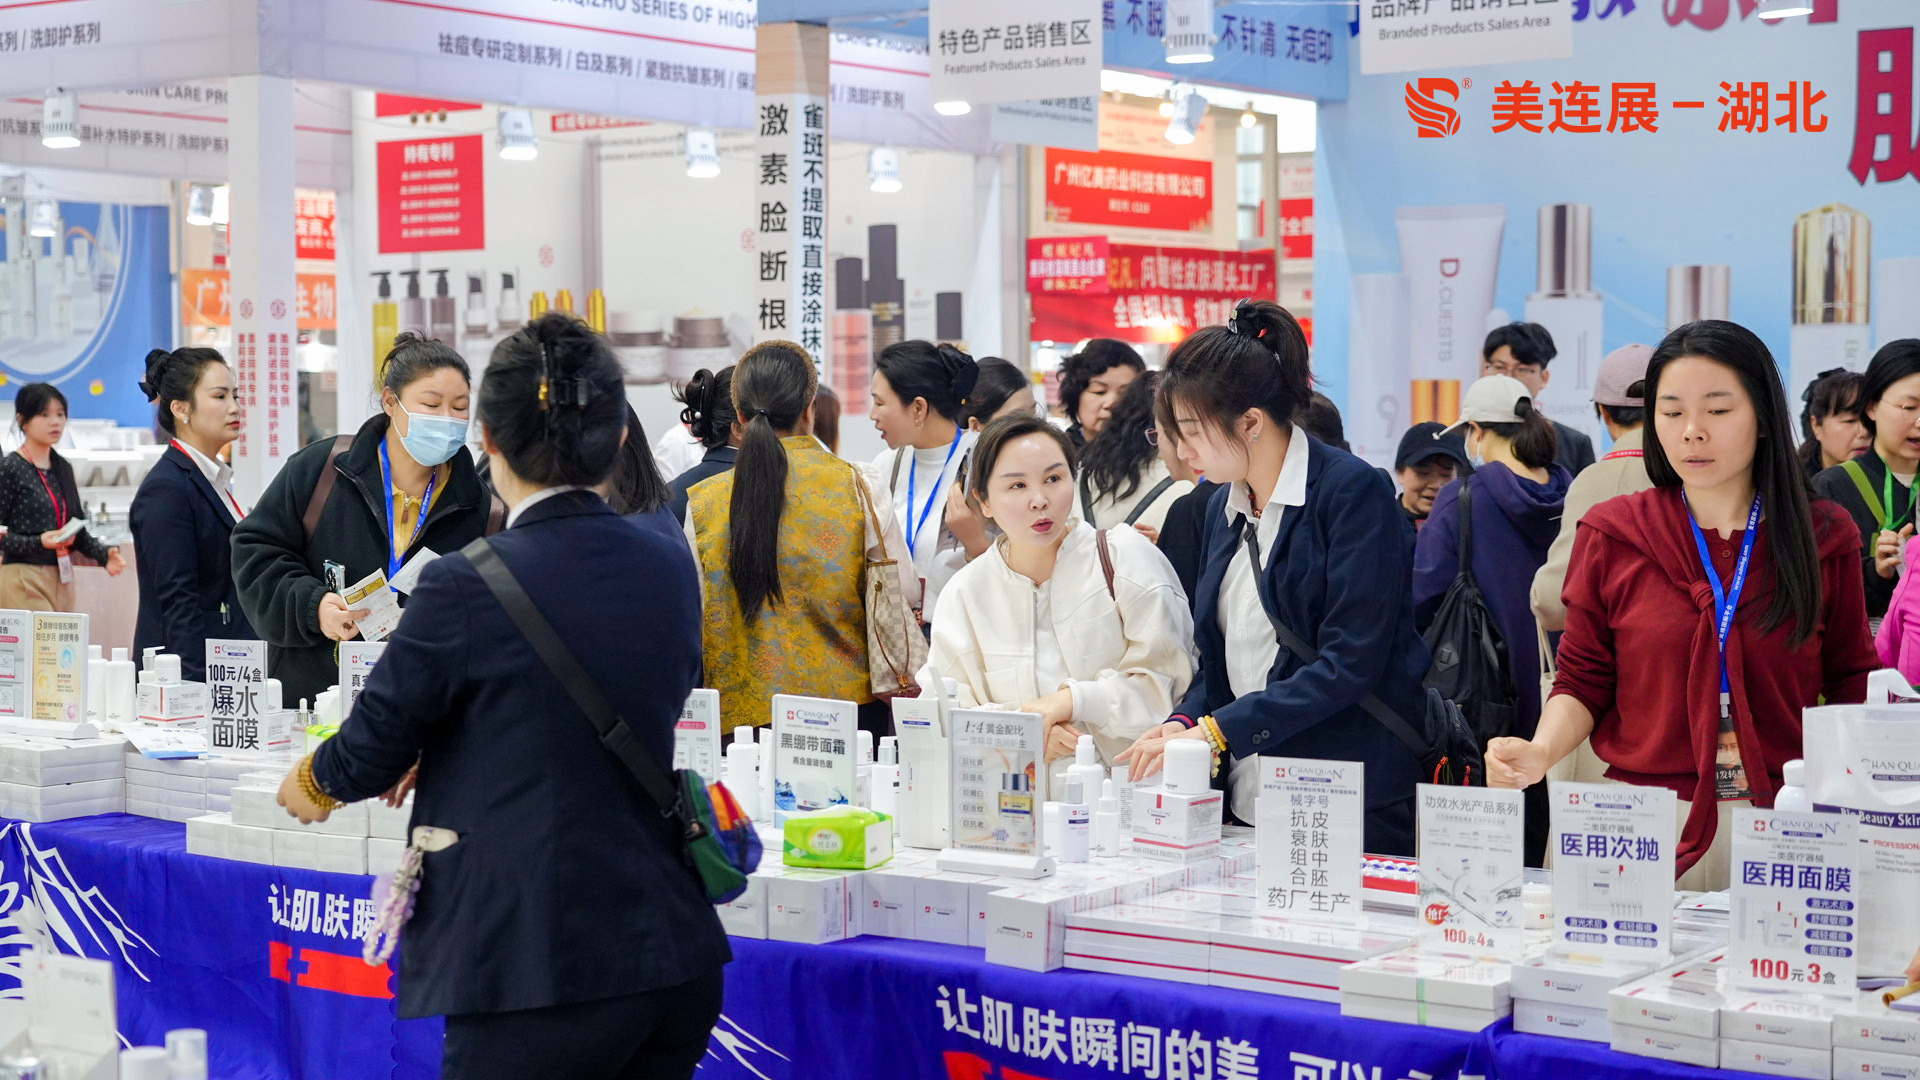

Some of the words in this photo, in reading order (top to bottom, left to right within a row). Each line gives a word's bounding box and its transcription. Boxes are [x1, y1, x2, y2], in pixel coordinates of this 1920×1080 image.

[631, 0, 688, 21] SERIES
[692, 5, 714, 24] OF
[30, 22, 101, 48] 洗卸护系列
[939, 19, 1091, 56] 特色产品销售区
[1379, 24, 1428, 41] Branded
[1431, 20, 1485, 36] Products
[1488, 17, 1519, 31] Sales
[1522, 15, 1551, 28] Area
[575, 51, 632, 77] 白及系列
[944, 61, 987, 75] Featured
[990, 57, 1033, 71] Products
[1036, 56, 1060, 69] Sales
[1064, 55, 1086, 67] Area
[759, 103, 788, 330] 激素脸断根
[210, 684, 260, 717] 爆水
[211, 717, 260, 750] 面膜
[985, 723, 1024, 736] 黄金配比
[780, 732, 847, 755] 黑绷带面霜
[1290, 793, 1330, 808] 械字号
[1425, 794, 1519, 817] 功效水光产品系列
[1583, 822, 1635, 834] 二类医疗器械
[1858, 810, 1894, 827] Beauty
[1290, 808, 1308, 887] 抗衰组合
[1311, 810, 1329, 888] 皮肤中胚
[1561, 832, 1660, 862] 医用次抛
[1767, 851, 1825, 863] 二类医疗器械
[1742, 861, 1852, 893] 医用面膜
[1268, 887, 1351, 914] 药厂生产
[1750, 958, 1837, 985] 100元3盒
